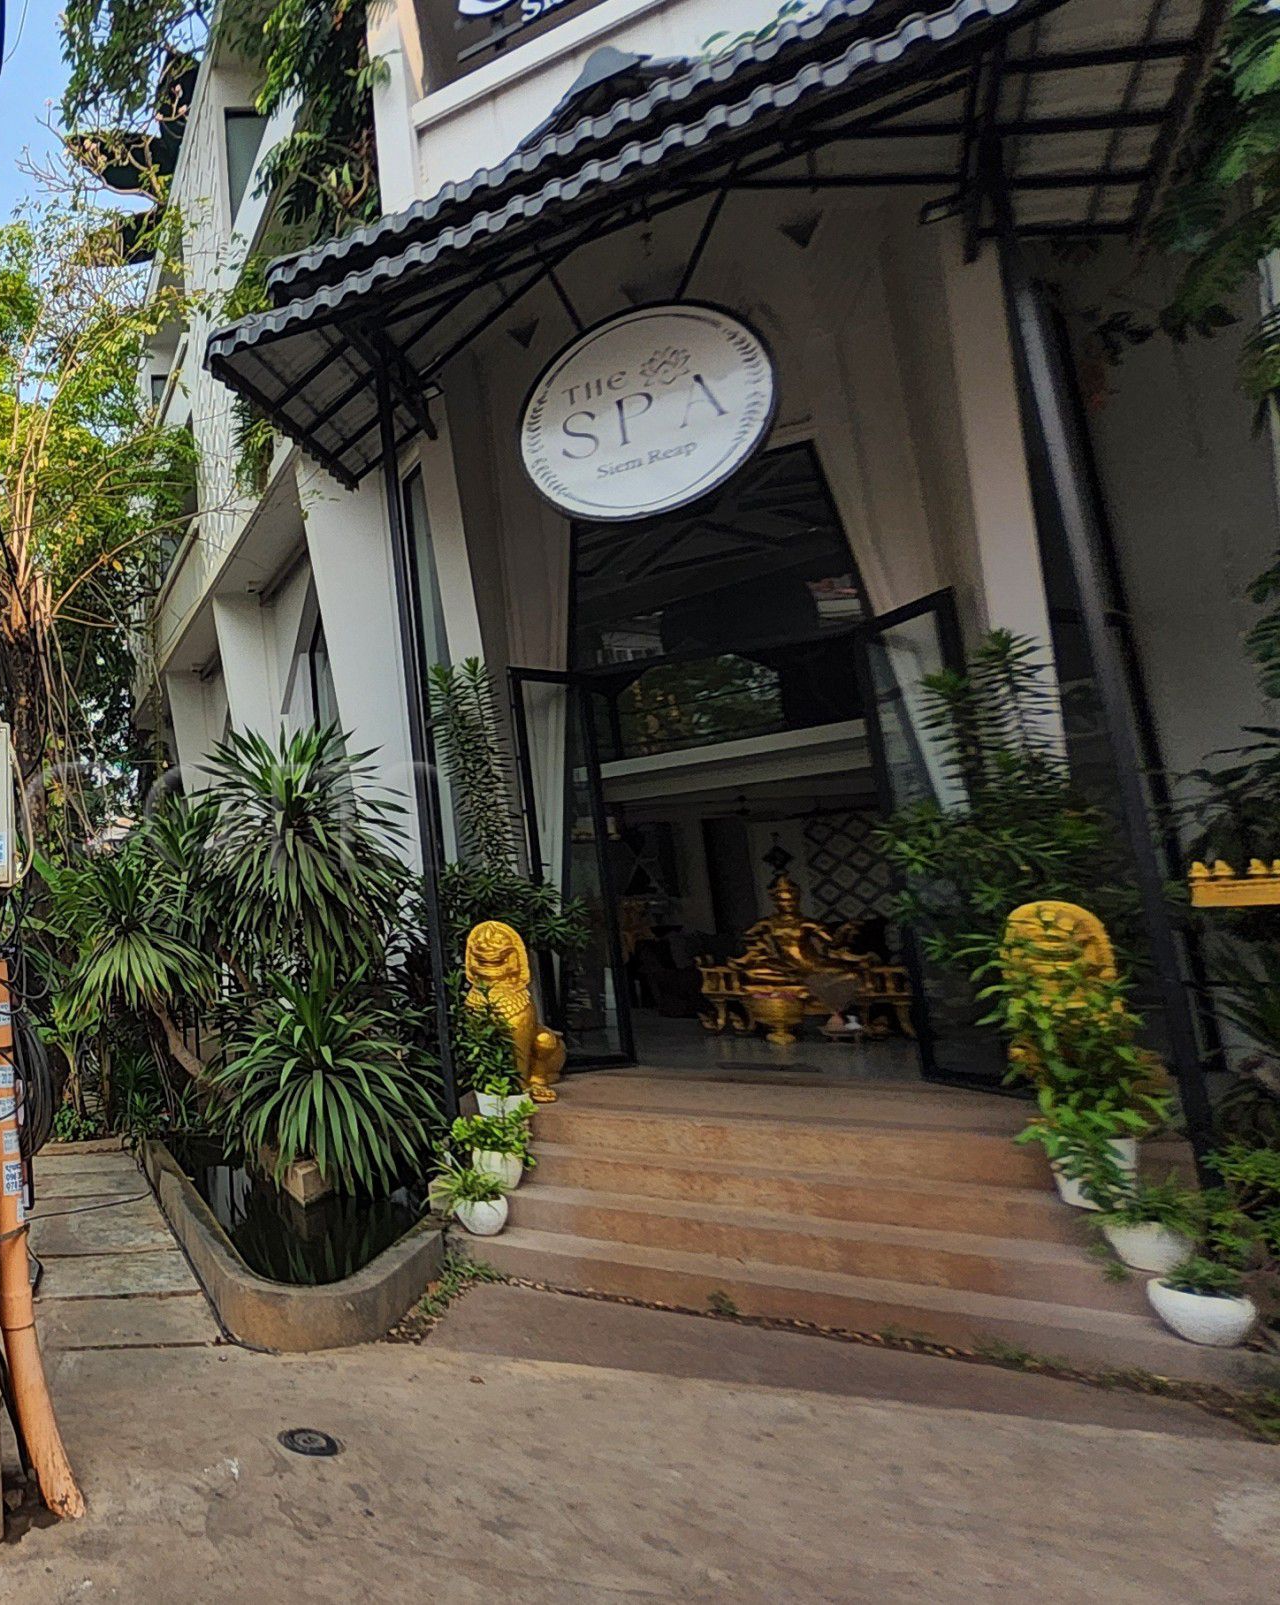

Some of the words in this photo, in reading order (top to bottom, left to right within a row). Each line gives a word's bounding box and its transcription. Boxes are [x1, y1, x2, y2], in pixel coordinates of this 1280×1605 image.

[561, 370, 627, 406] THE
[562, 373, 729, 459] SPA
[596, 457, 643, 479] Siem
[648, 442, 698, 465] Reap
